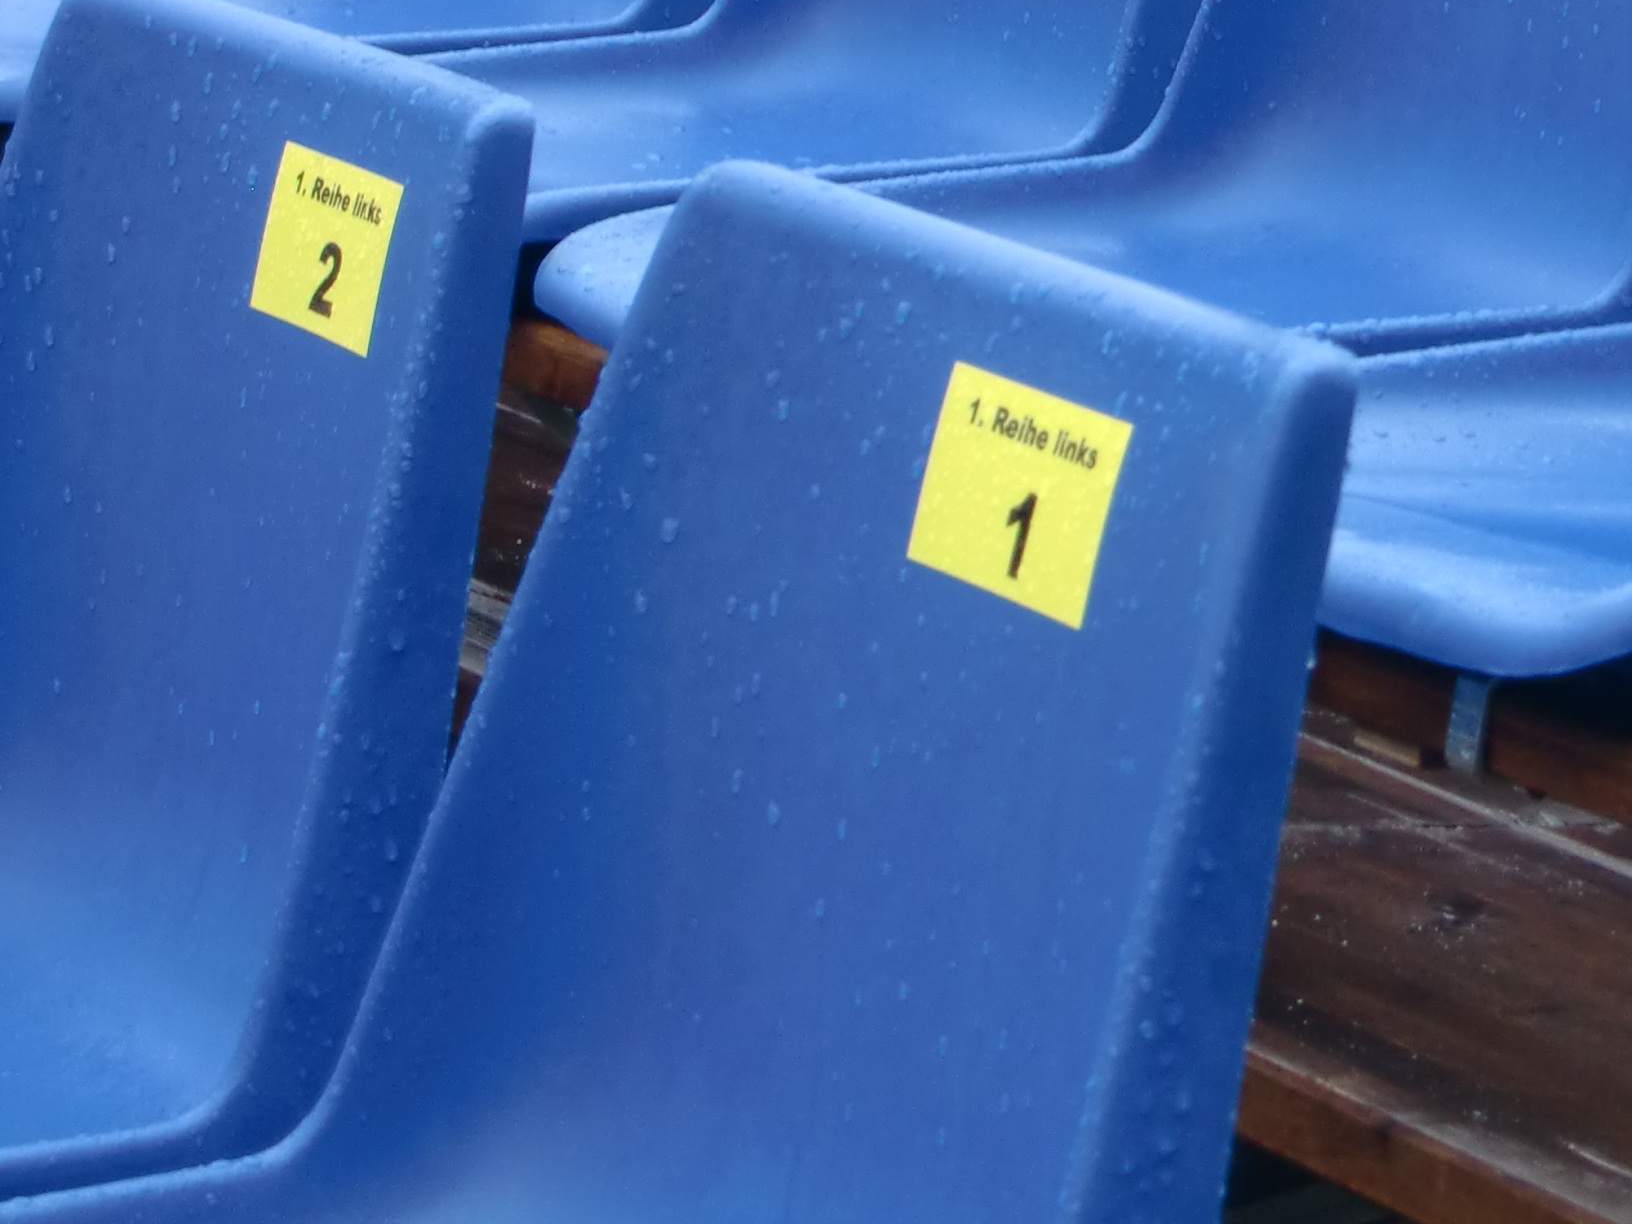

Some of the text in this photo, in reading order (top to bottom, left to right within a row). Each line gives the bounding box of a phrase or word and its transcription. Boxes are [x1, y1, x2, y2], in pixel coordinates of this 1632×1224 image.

[296, 170, 382, 226] 1. Reihe links
[307, 241, 343, 319] 2
[969, 397, 1099, 471] 1. Reihe links
[1006, 492, 1038, 579] 1
